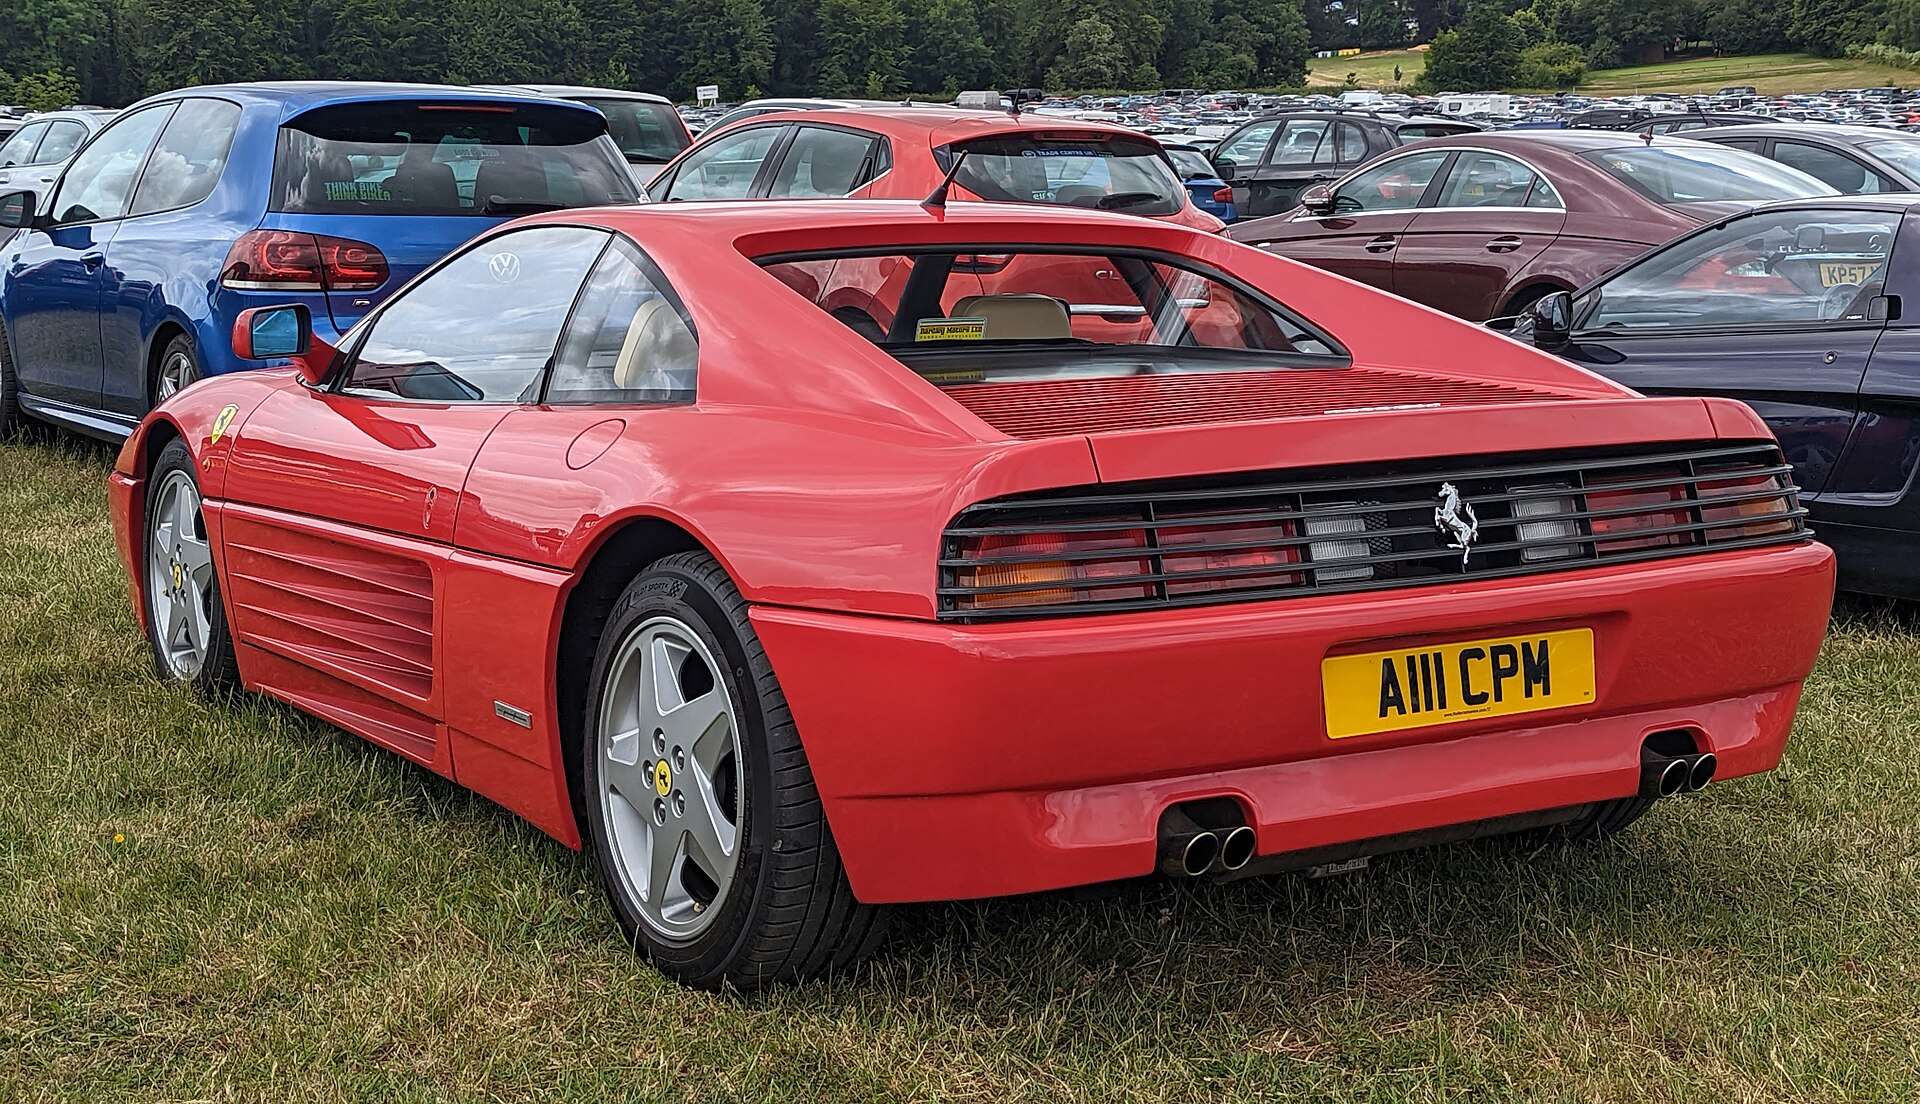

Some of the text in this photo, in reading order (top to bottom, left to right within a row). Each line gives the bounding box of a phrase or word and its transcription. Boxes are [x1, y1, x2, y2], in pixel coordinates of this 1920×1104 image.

[1095, 270, 1121, 280] CL
[1826, 266, 1866, 284] KP57
[1459, 639, 1551, 706] CPM
